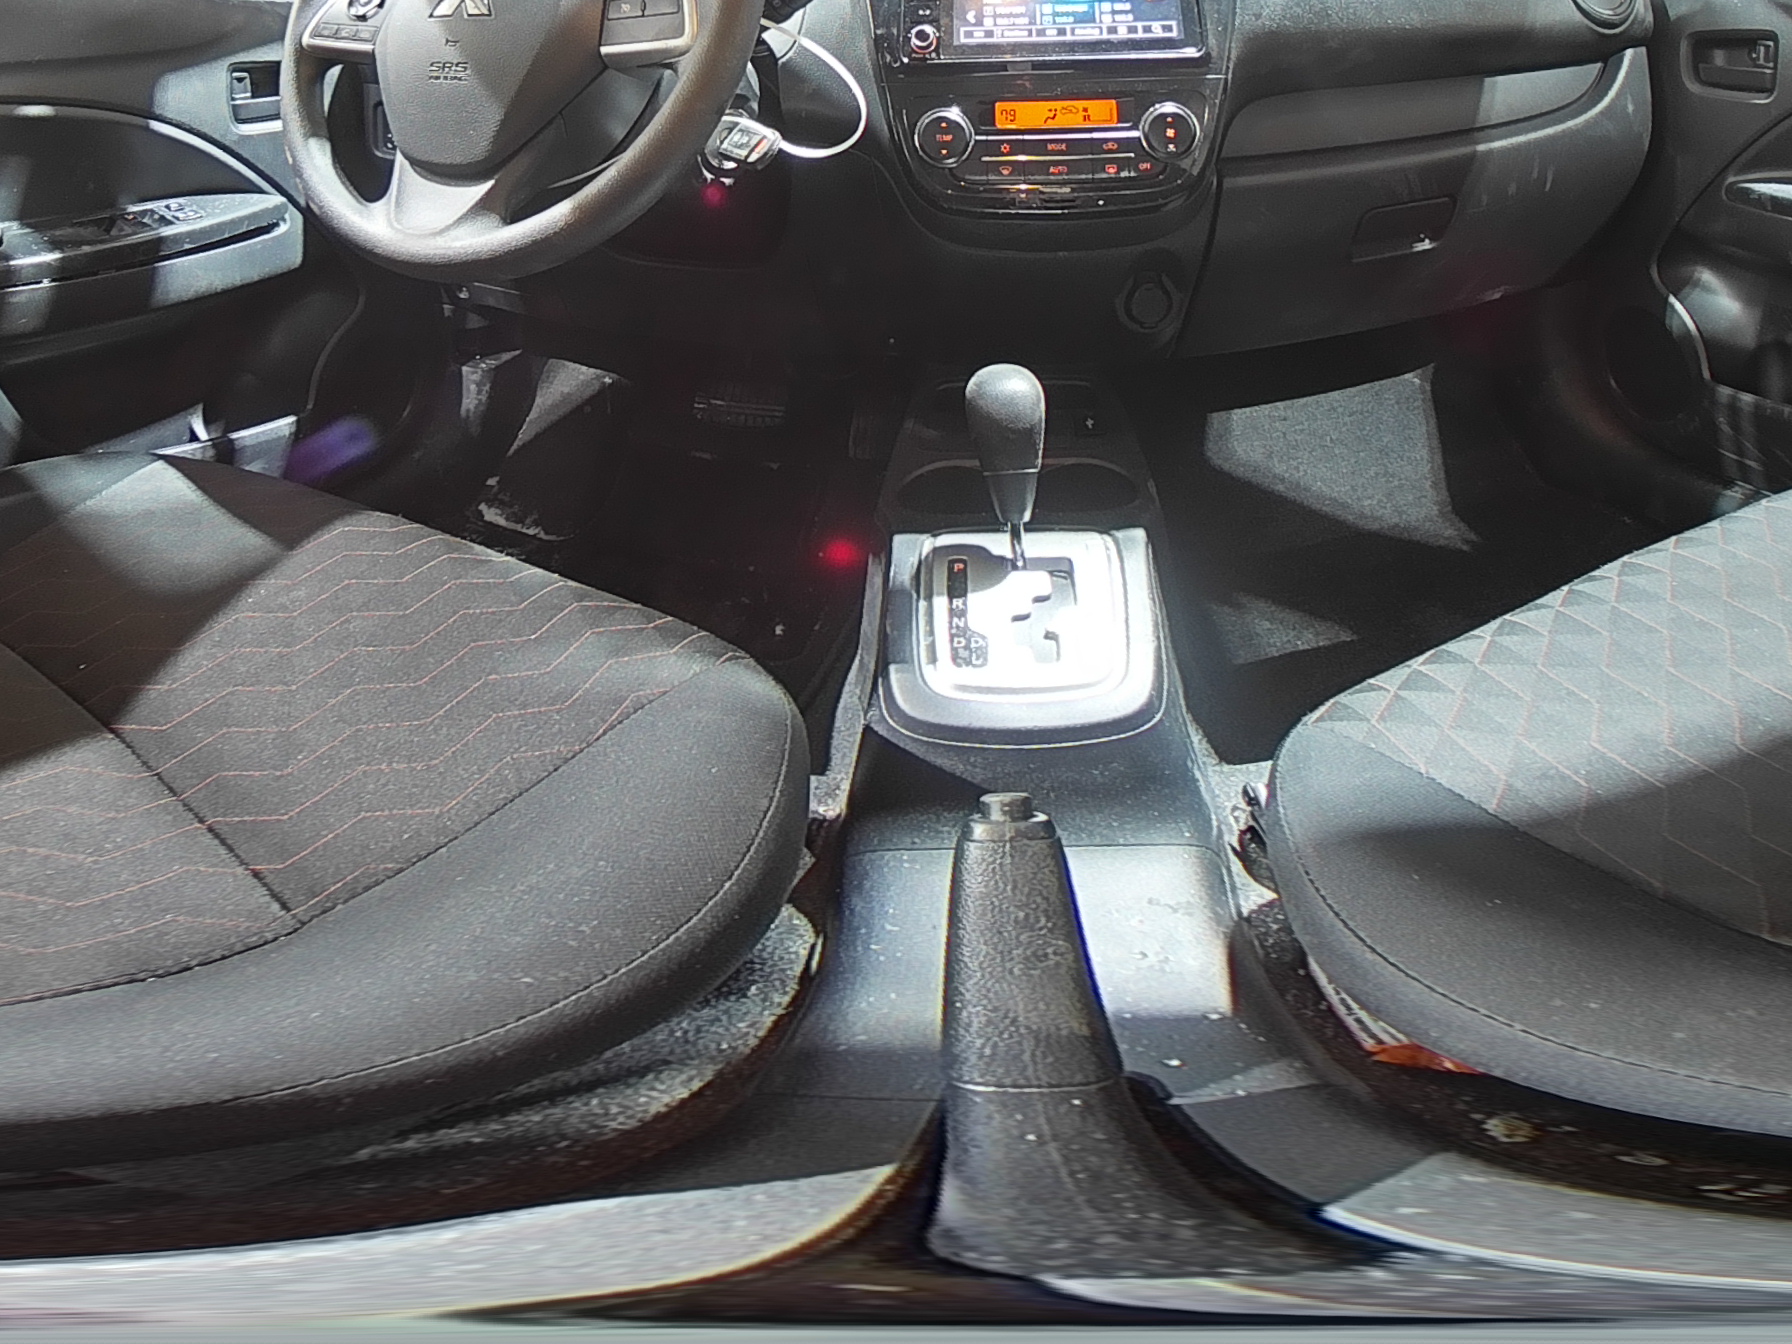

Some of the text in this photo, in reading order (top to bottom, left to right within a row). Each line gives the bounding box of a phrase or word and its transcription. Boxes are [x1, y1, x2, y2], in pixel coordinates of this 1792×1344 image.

[428, 61, 469, 73] SRS
[935, 134, 953, 143] TEMP
[1046, 142, 1067, 152] MODE
[1048, 165, 1068, 174] AUTO
[953, 563, 965, 573] P
[952, 597, 966, 609] R
[952, 617, 965, 628] N
[953, 637, 966, 648] D
